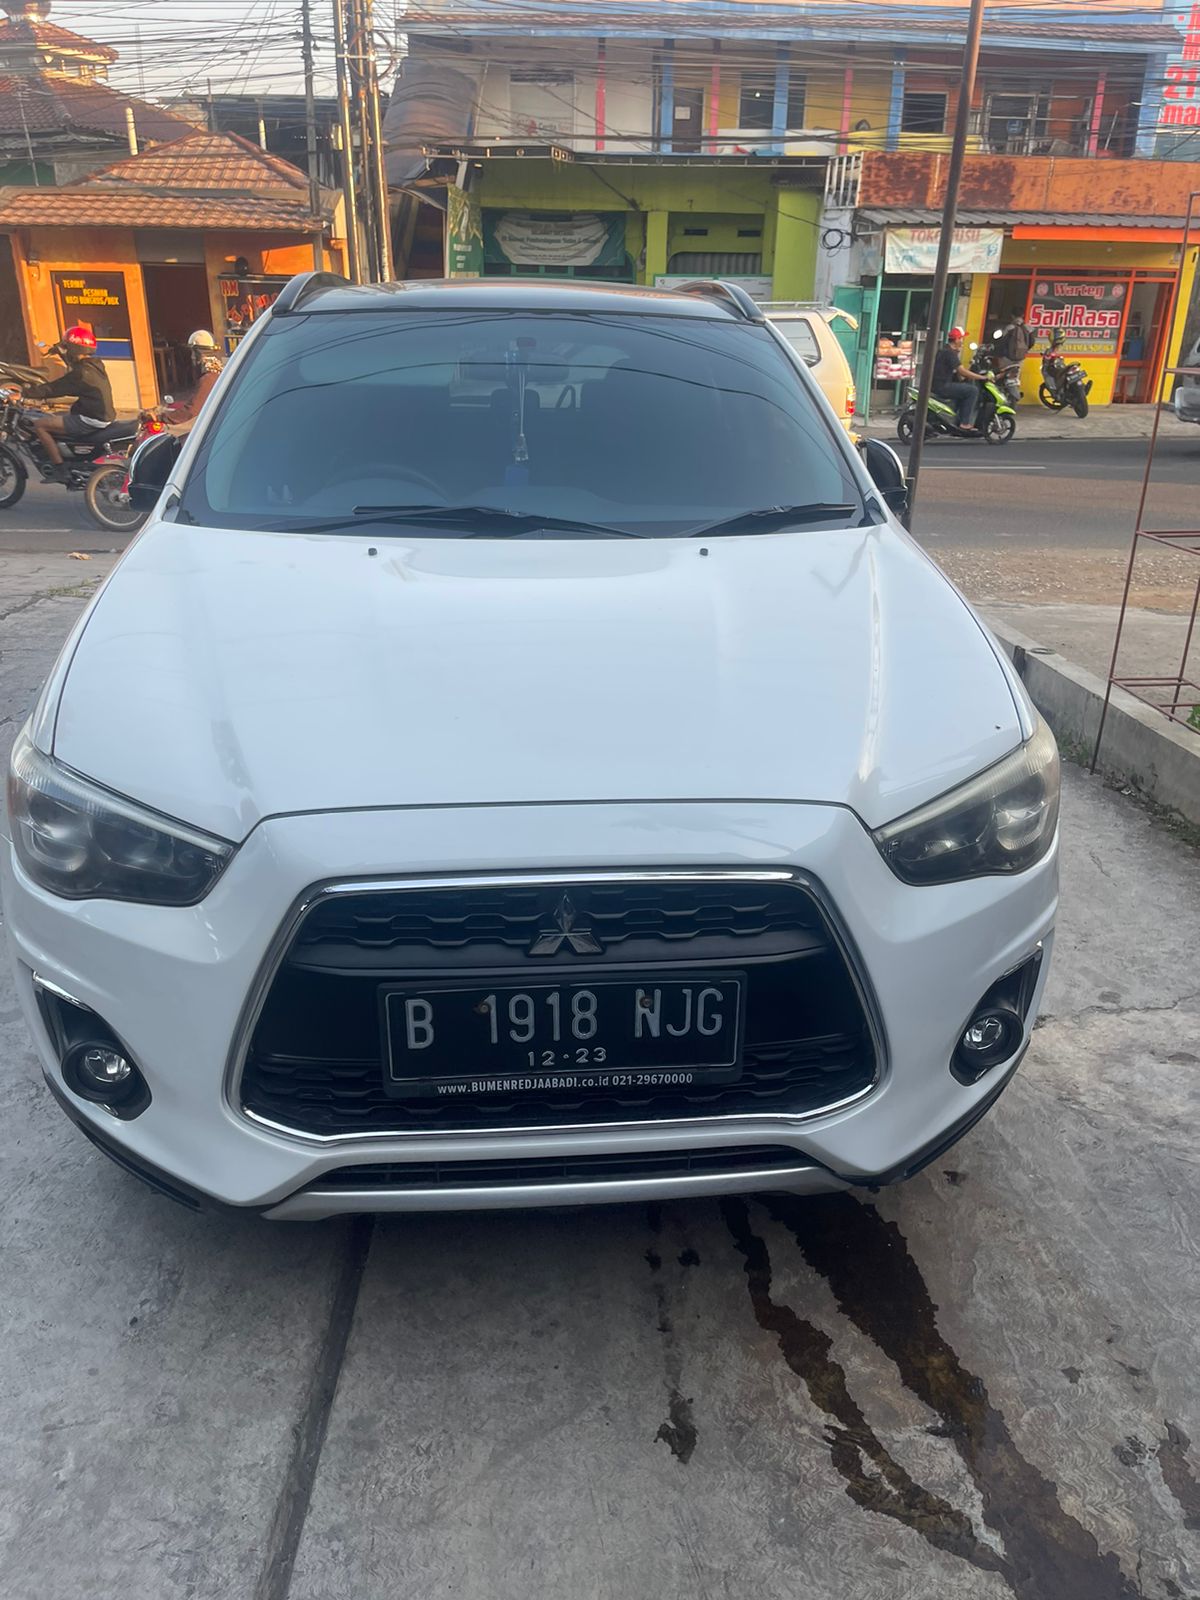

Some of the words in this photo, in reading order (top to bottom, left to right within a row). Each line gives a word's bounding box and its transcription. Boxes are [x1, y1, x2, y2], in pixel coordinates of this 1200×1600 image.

[1054, 283, 1104, 300] Warteg
[1029, 304, 1071, 327] Sari
[1071, 305, 1121, 327] Rasa
[405, 998, 434, 1049] B
[482, 990, 598, 1044] 1918
[634, 988, 724, 1038] NJG
[437, 1075, 610, 1095] www.BUMENREDJAABADI.co.id
[611, 1073, 694, 1087] 021-29670000
